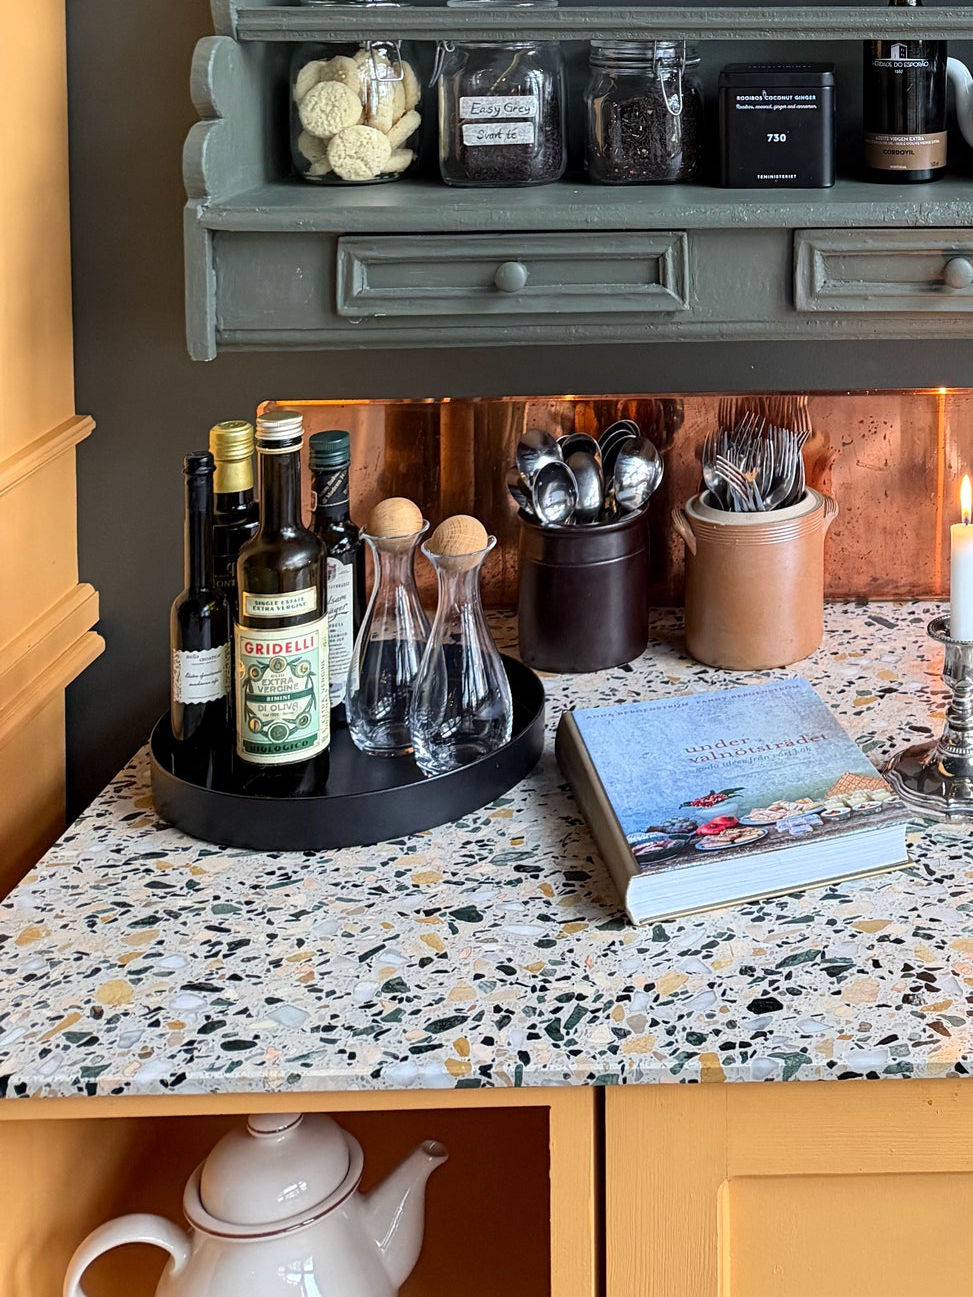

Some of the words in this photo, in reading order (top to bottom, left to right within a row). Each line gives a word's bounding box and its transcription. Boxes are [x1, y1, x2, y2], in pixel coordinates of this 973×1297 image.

[471, 102, 500, 117] Easy
[503, 102, 530, 115] Grey
[477, 127, 502, 140] Svart
[766, 133, 787, 143] 730
[276, 602, 306, 611] VERGINE
[281, 597, 304, 605] ESTATE
[244, 636, 314, 655] GRIDELLI
[261, 677, 294, 686] EXTRA
[257, 683, 299, 693] VERGINE
[270, 702, 299, 712] OLIVA
[249, 740, 309, 753] BIOLOGICO
[685, 737, 750, 754] under
[689, 733, 829, 764] valnötsträdet
